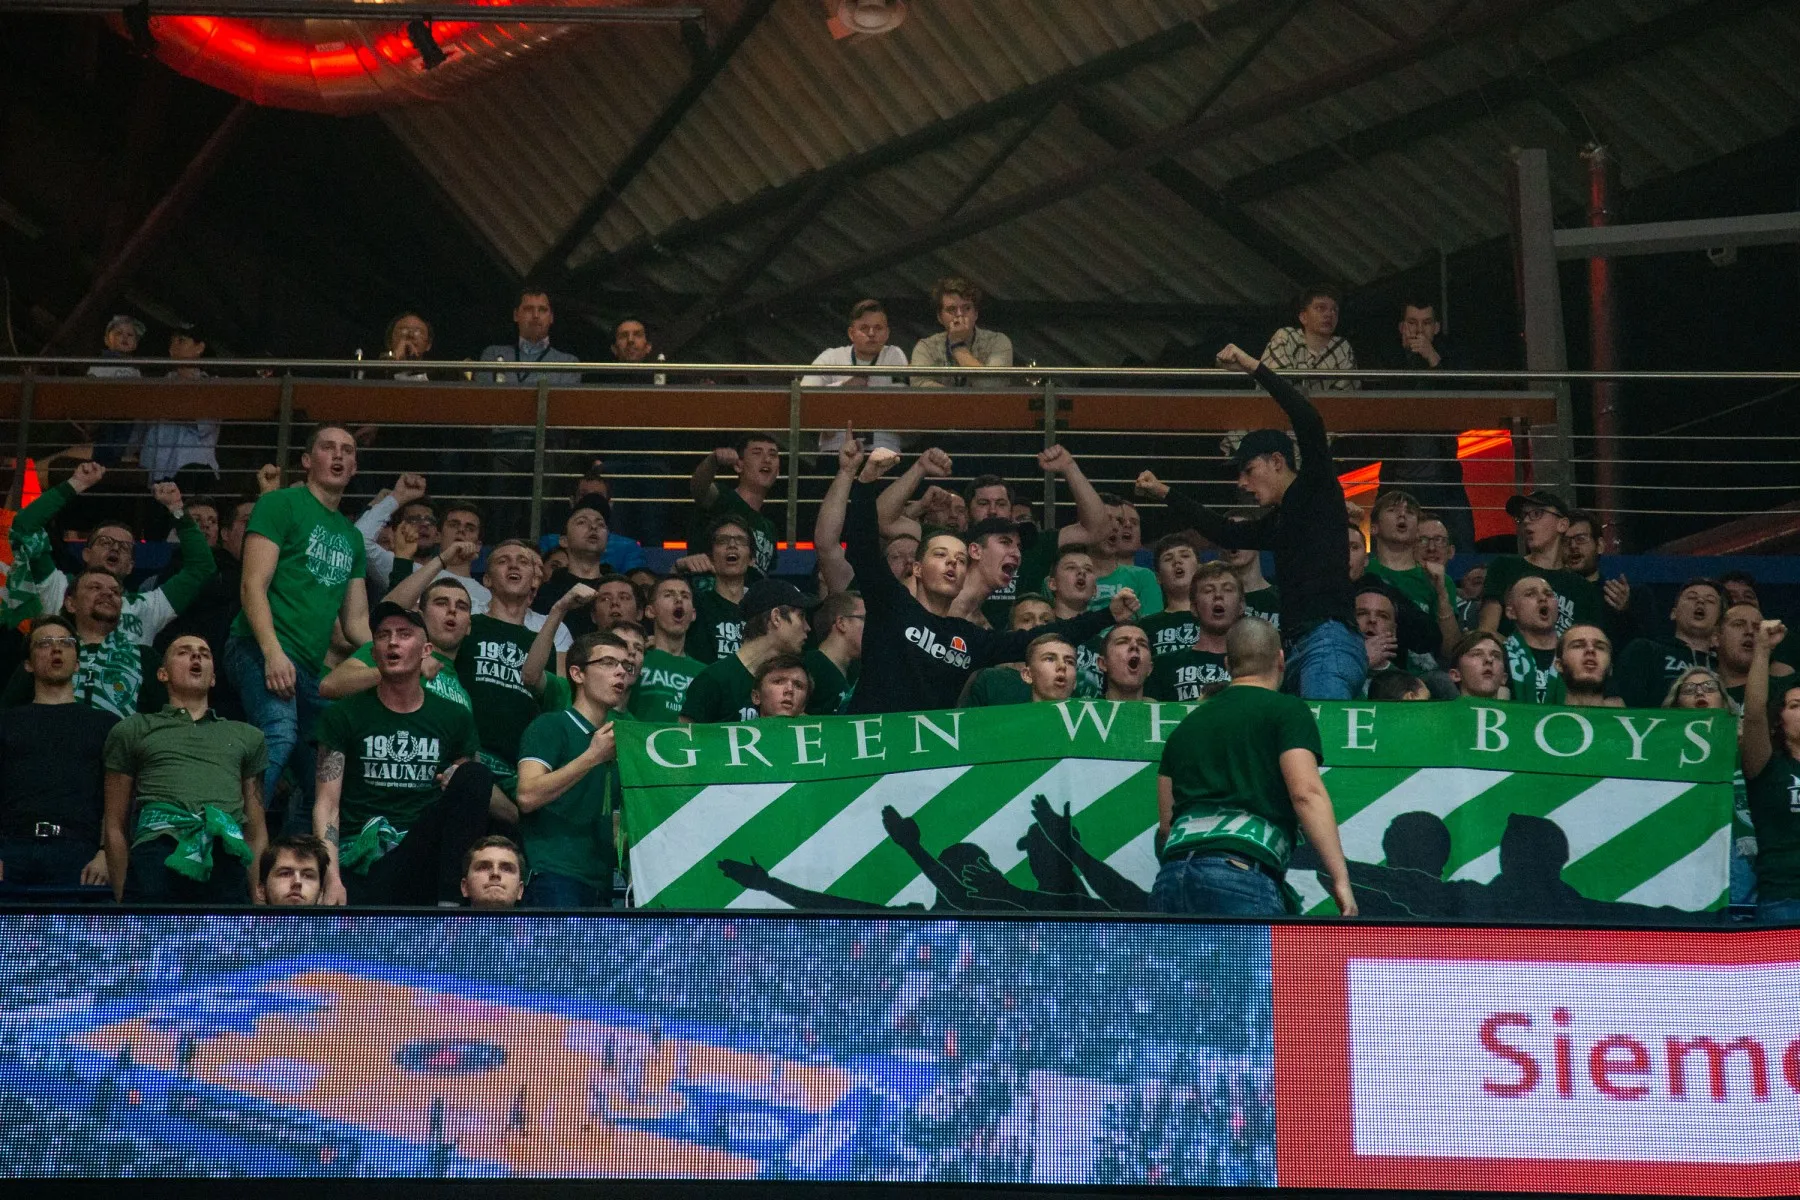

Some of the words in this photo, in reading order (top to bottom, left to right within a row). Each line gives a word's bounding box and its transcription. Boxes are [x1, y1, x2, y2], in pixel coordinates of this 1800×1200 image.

[1156, 627, 1177, 644] 19
[477, 640, 500, 659] 19
[904, 626, 972, 670] ellesse
[1175, 665, 1199, 684] 19
[645, 711, 966, 768] GREEN
[1052, 700, 1377, 753] WHE
[1469, 706, 1715, 768] BOYS
[363, 735, 388, 758] 19
[417, 737, 440, 761] 44
[363, 762, 437, 781] KAUNAS
